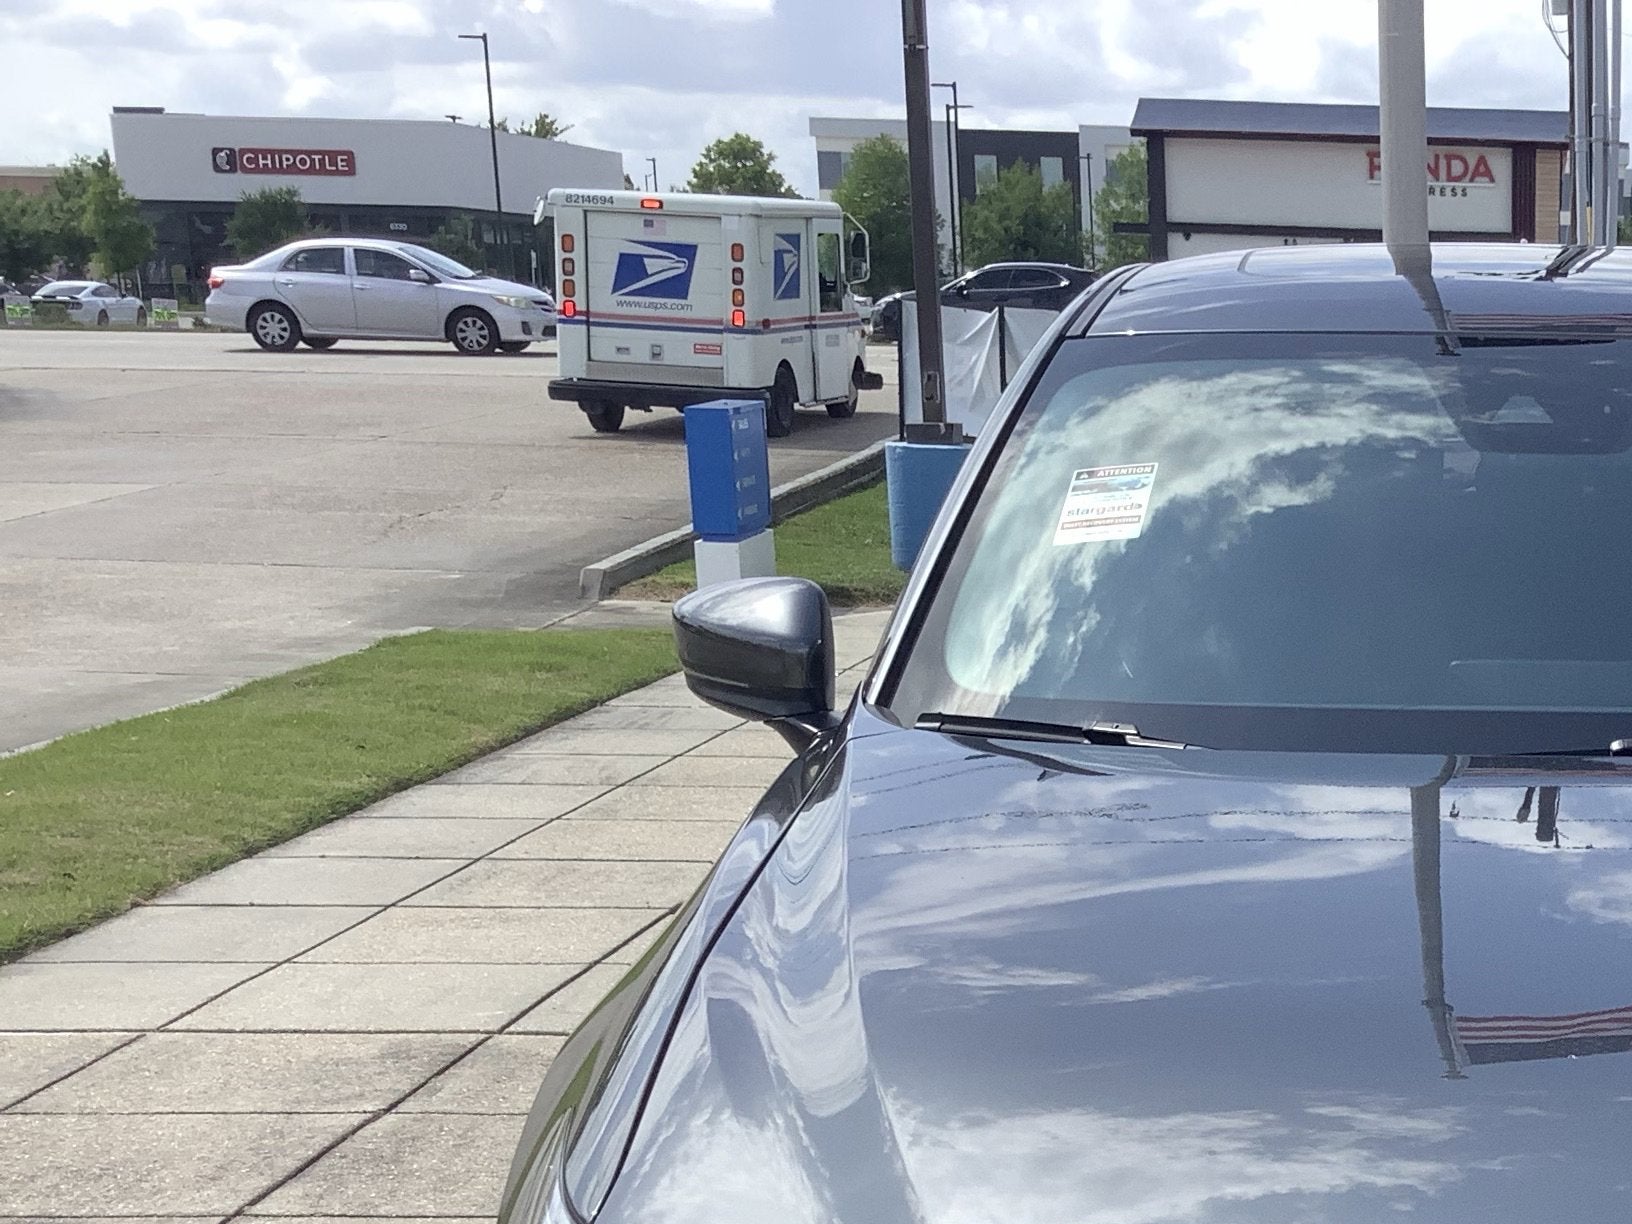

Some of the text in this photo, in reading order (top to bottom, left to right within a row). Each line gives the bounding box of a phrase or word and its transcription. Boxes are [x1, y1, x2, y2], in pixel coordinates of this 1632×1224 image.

[242, 153, 350, 171] CHIPOTLE
[1366, 151, 1496, 183] PNDA
[1428, 186, 1468, 197] RESS
[565, 193, 615, 206] 8214694
[616, 299, 693, 312] www.usps.com
[1096, 465, 1153, 477] ATTENTION
